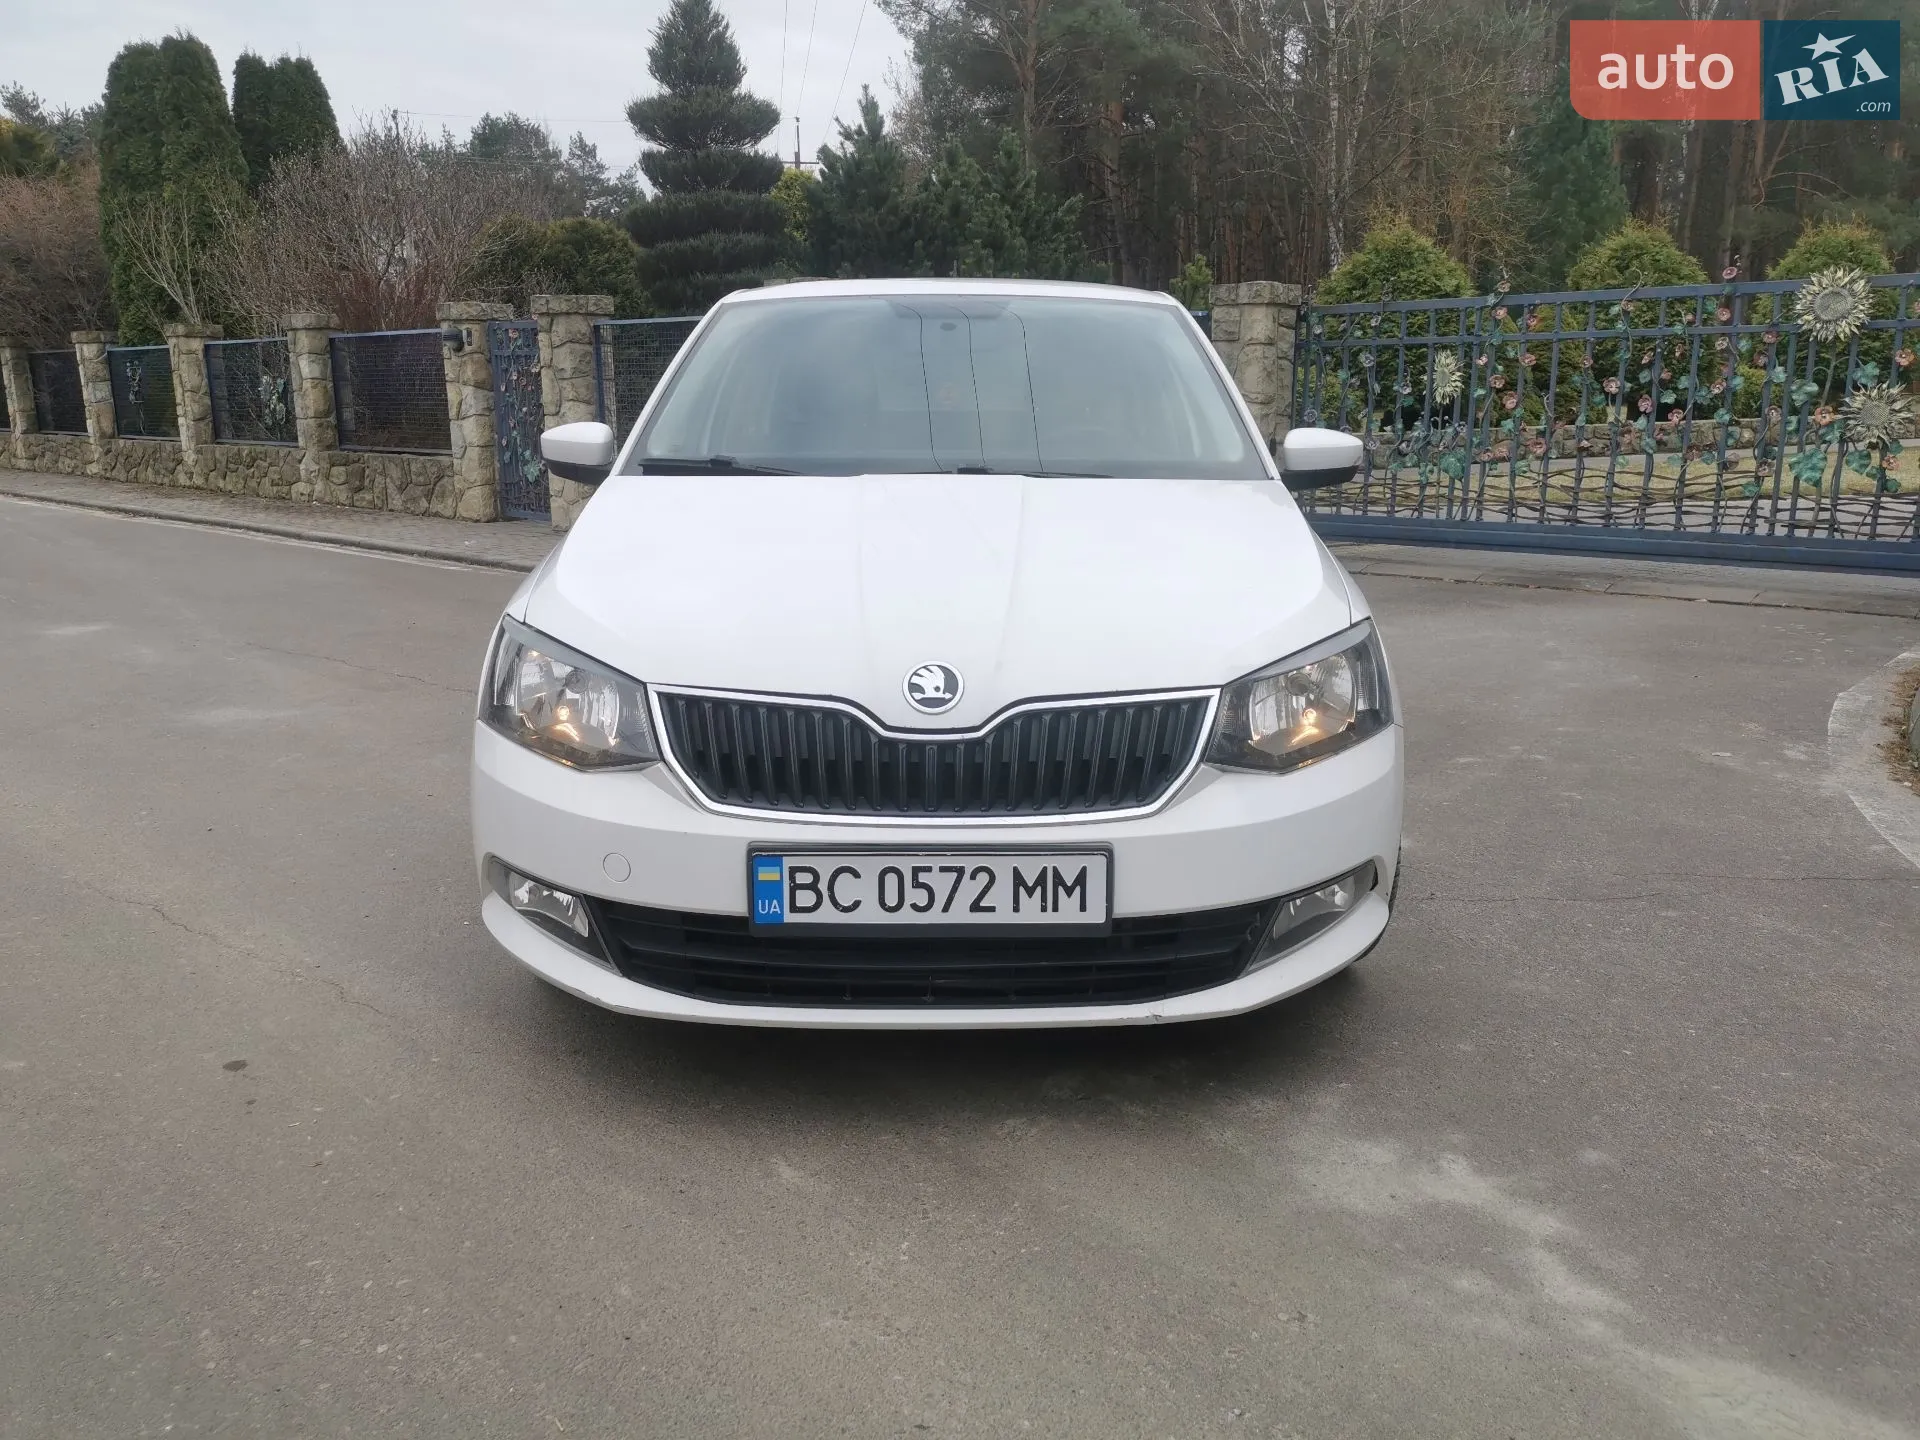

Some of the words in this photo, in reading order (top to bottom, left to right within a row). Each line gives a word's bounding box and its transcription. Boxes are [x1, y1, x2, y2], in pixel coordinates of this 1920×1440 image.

[787, 865, 863, 914] BC
[877, 864, 997, 914] 0572
[1012, 864, 1088, 913] MM
[757, 900, 782, 916] UA
